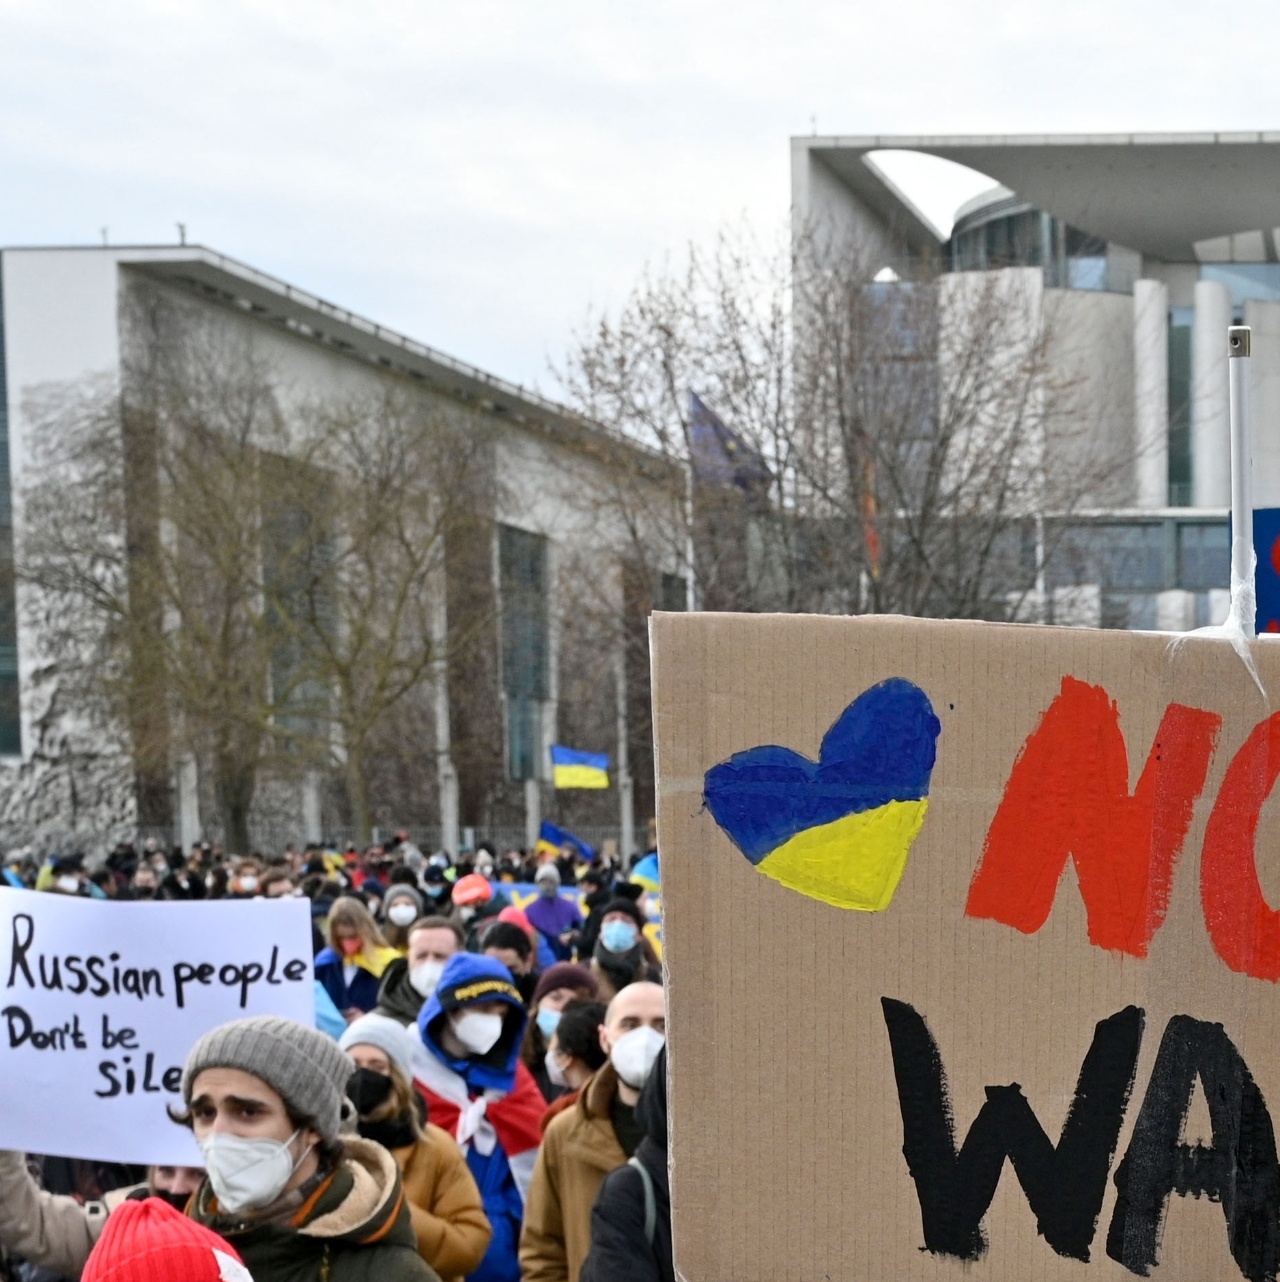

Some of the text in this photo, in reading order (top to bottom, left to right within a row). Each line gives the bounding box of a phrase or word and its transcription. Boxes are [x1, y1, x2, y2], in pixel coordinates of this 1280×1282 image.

[7, 914, 307, 1008] Russian people
[1, 1005, 139, 1050] Don't be
